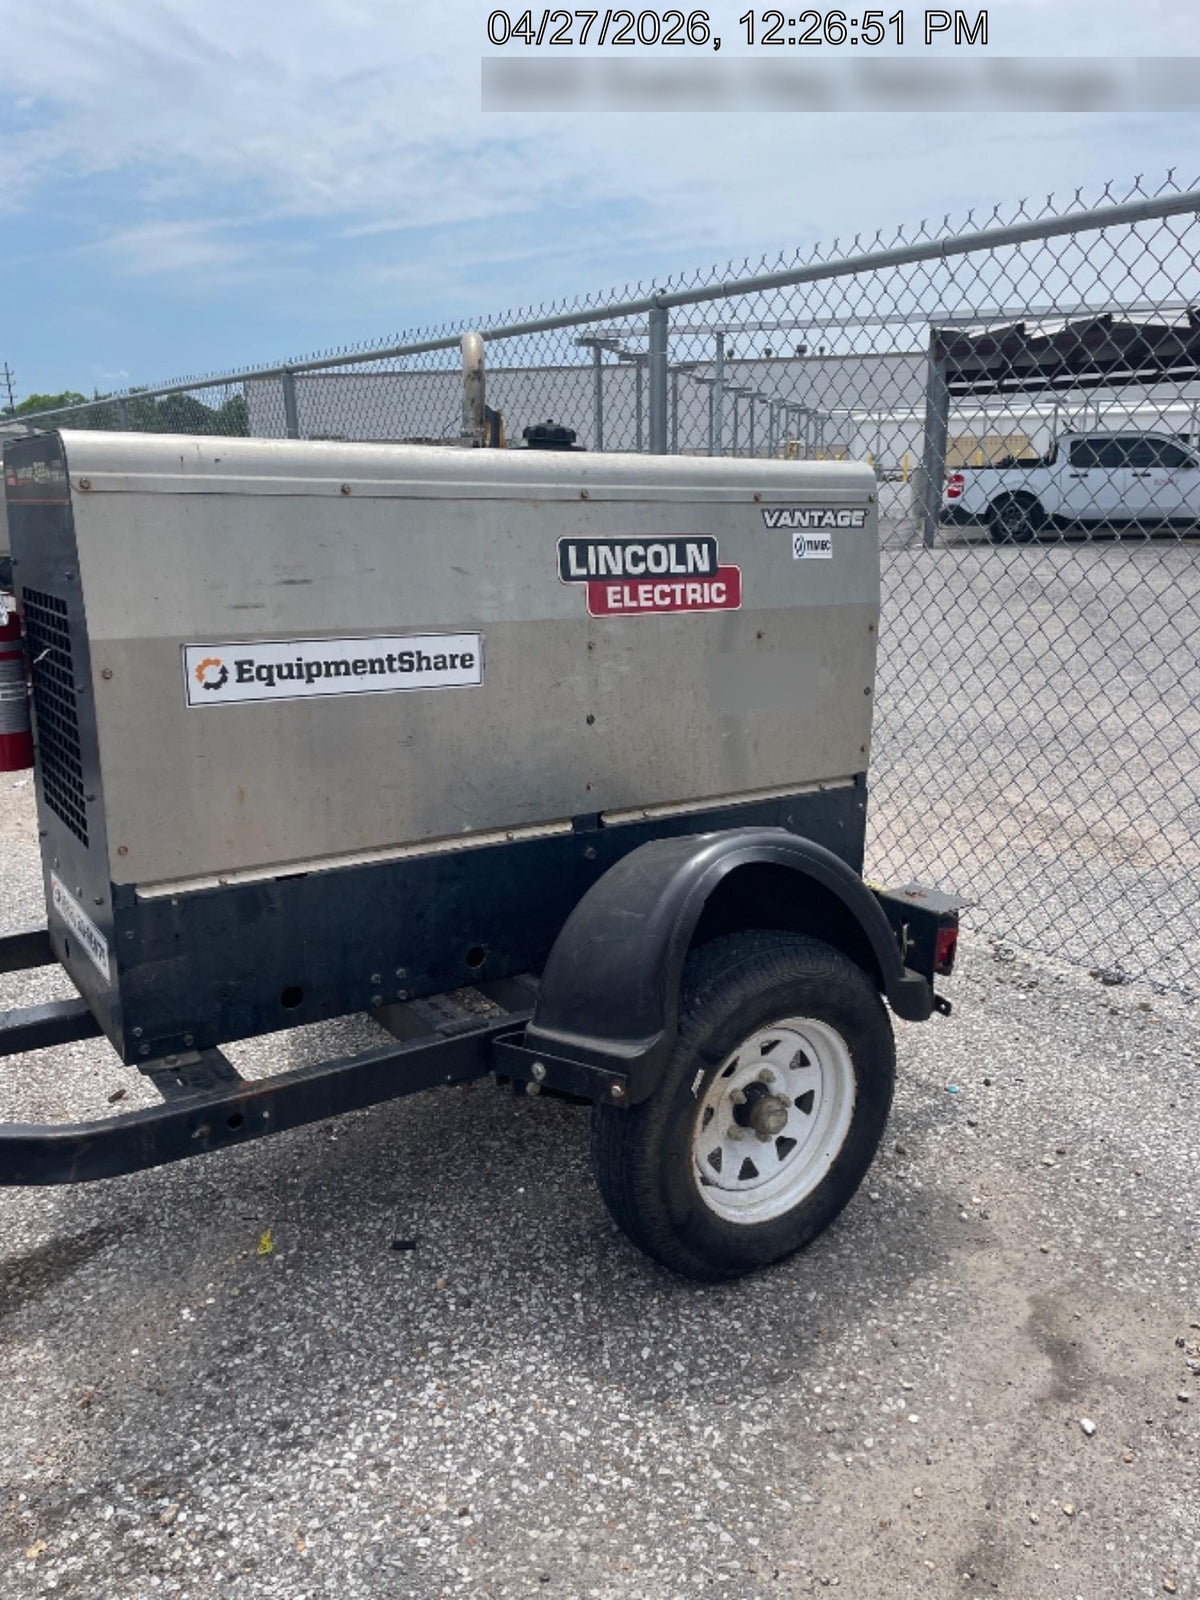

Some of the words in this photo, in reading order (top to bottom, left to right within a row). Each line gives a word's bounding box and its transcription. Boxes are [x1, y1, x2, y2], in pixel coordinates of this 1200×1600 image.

[762, 509, 866, 528] VANTAGE
[568, 543, 711, 577] LINCOLN
[606, 582, 727, 609] ELECTRIC
[234, 651, 475, 687] EquipmentShare
